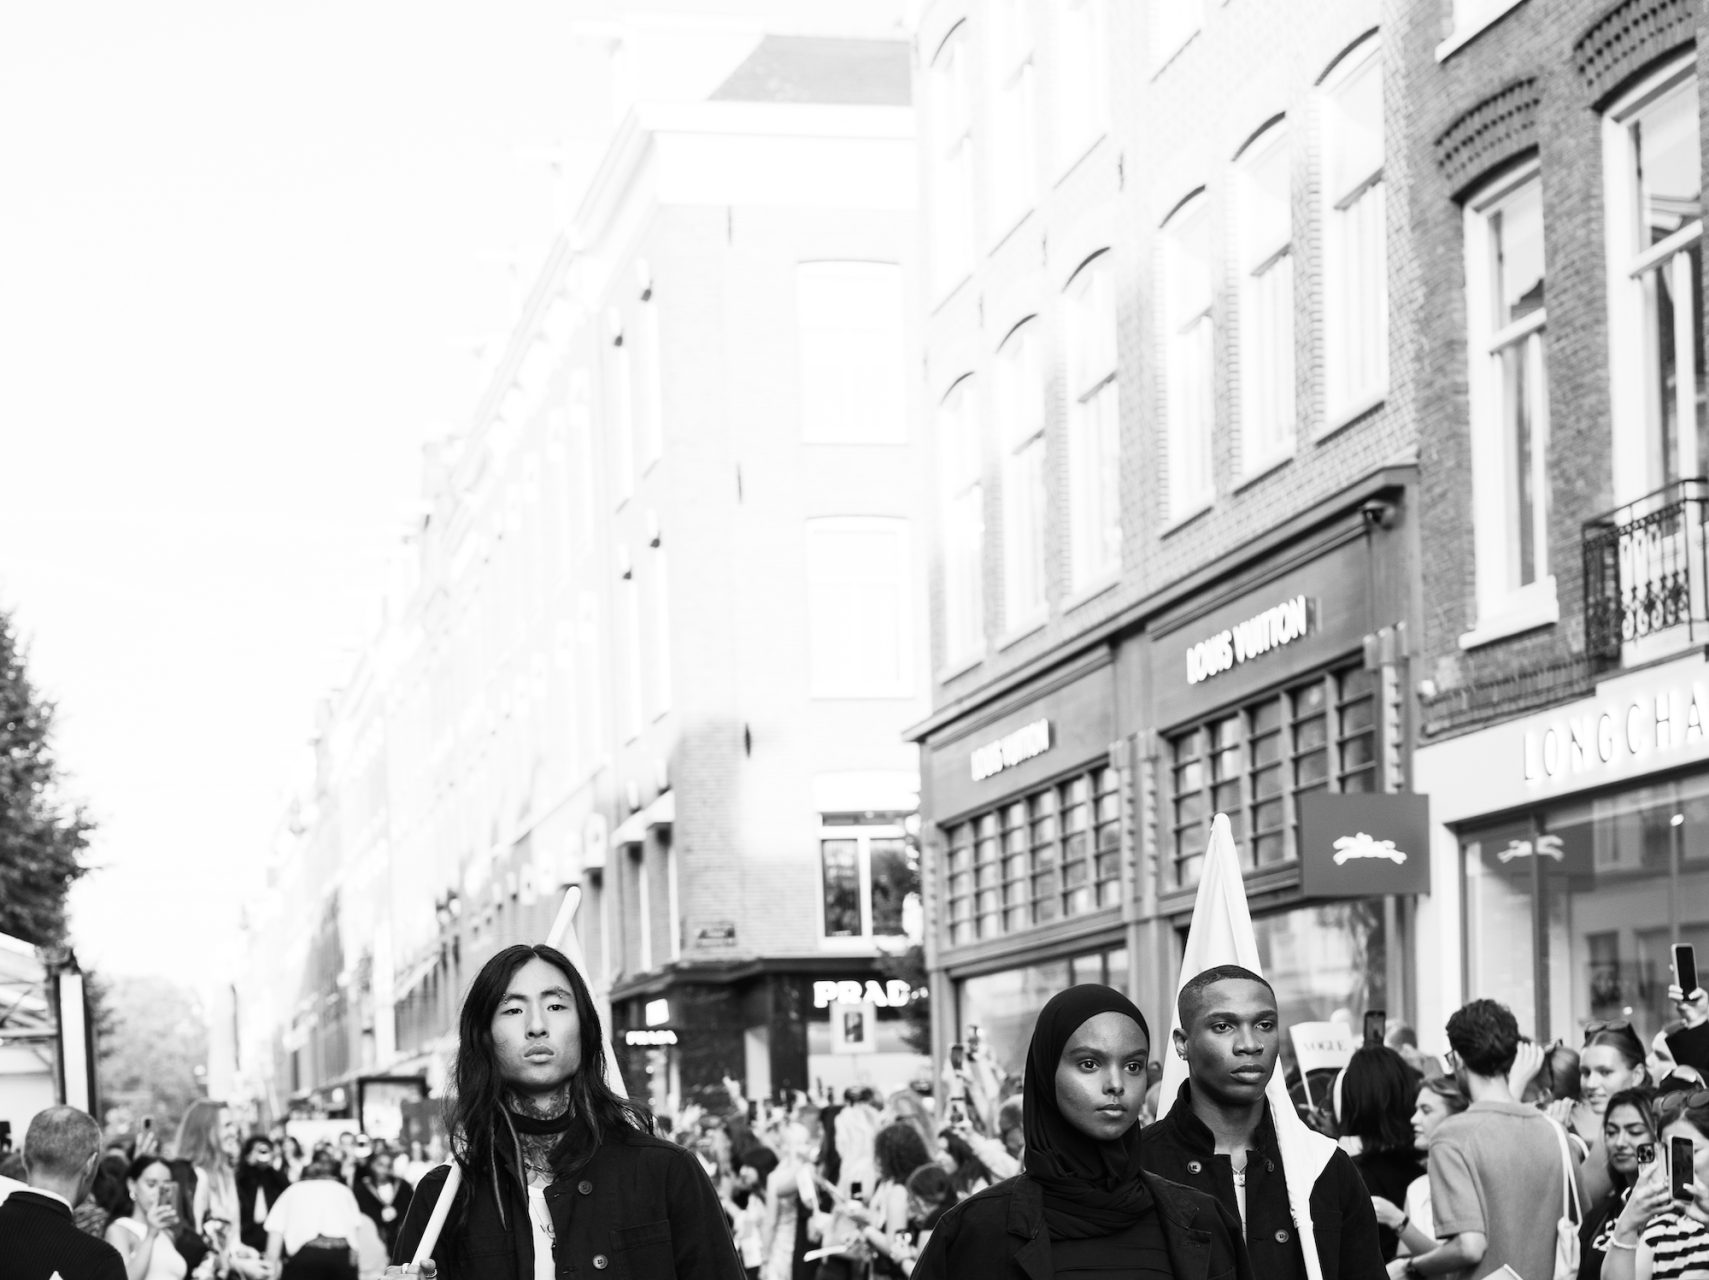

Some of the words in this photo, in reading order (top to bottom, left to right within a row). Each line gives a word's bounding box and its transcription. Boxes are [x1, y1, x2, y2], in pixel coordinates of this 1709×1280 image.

[1186, 629, 1233, 684] LOUIS
[1232, 594, 1306, 663] VUITTON
[813, 979, 927, 1008] PRAD
